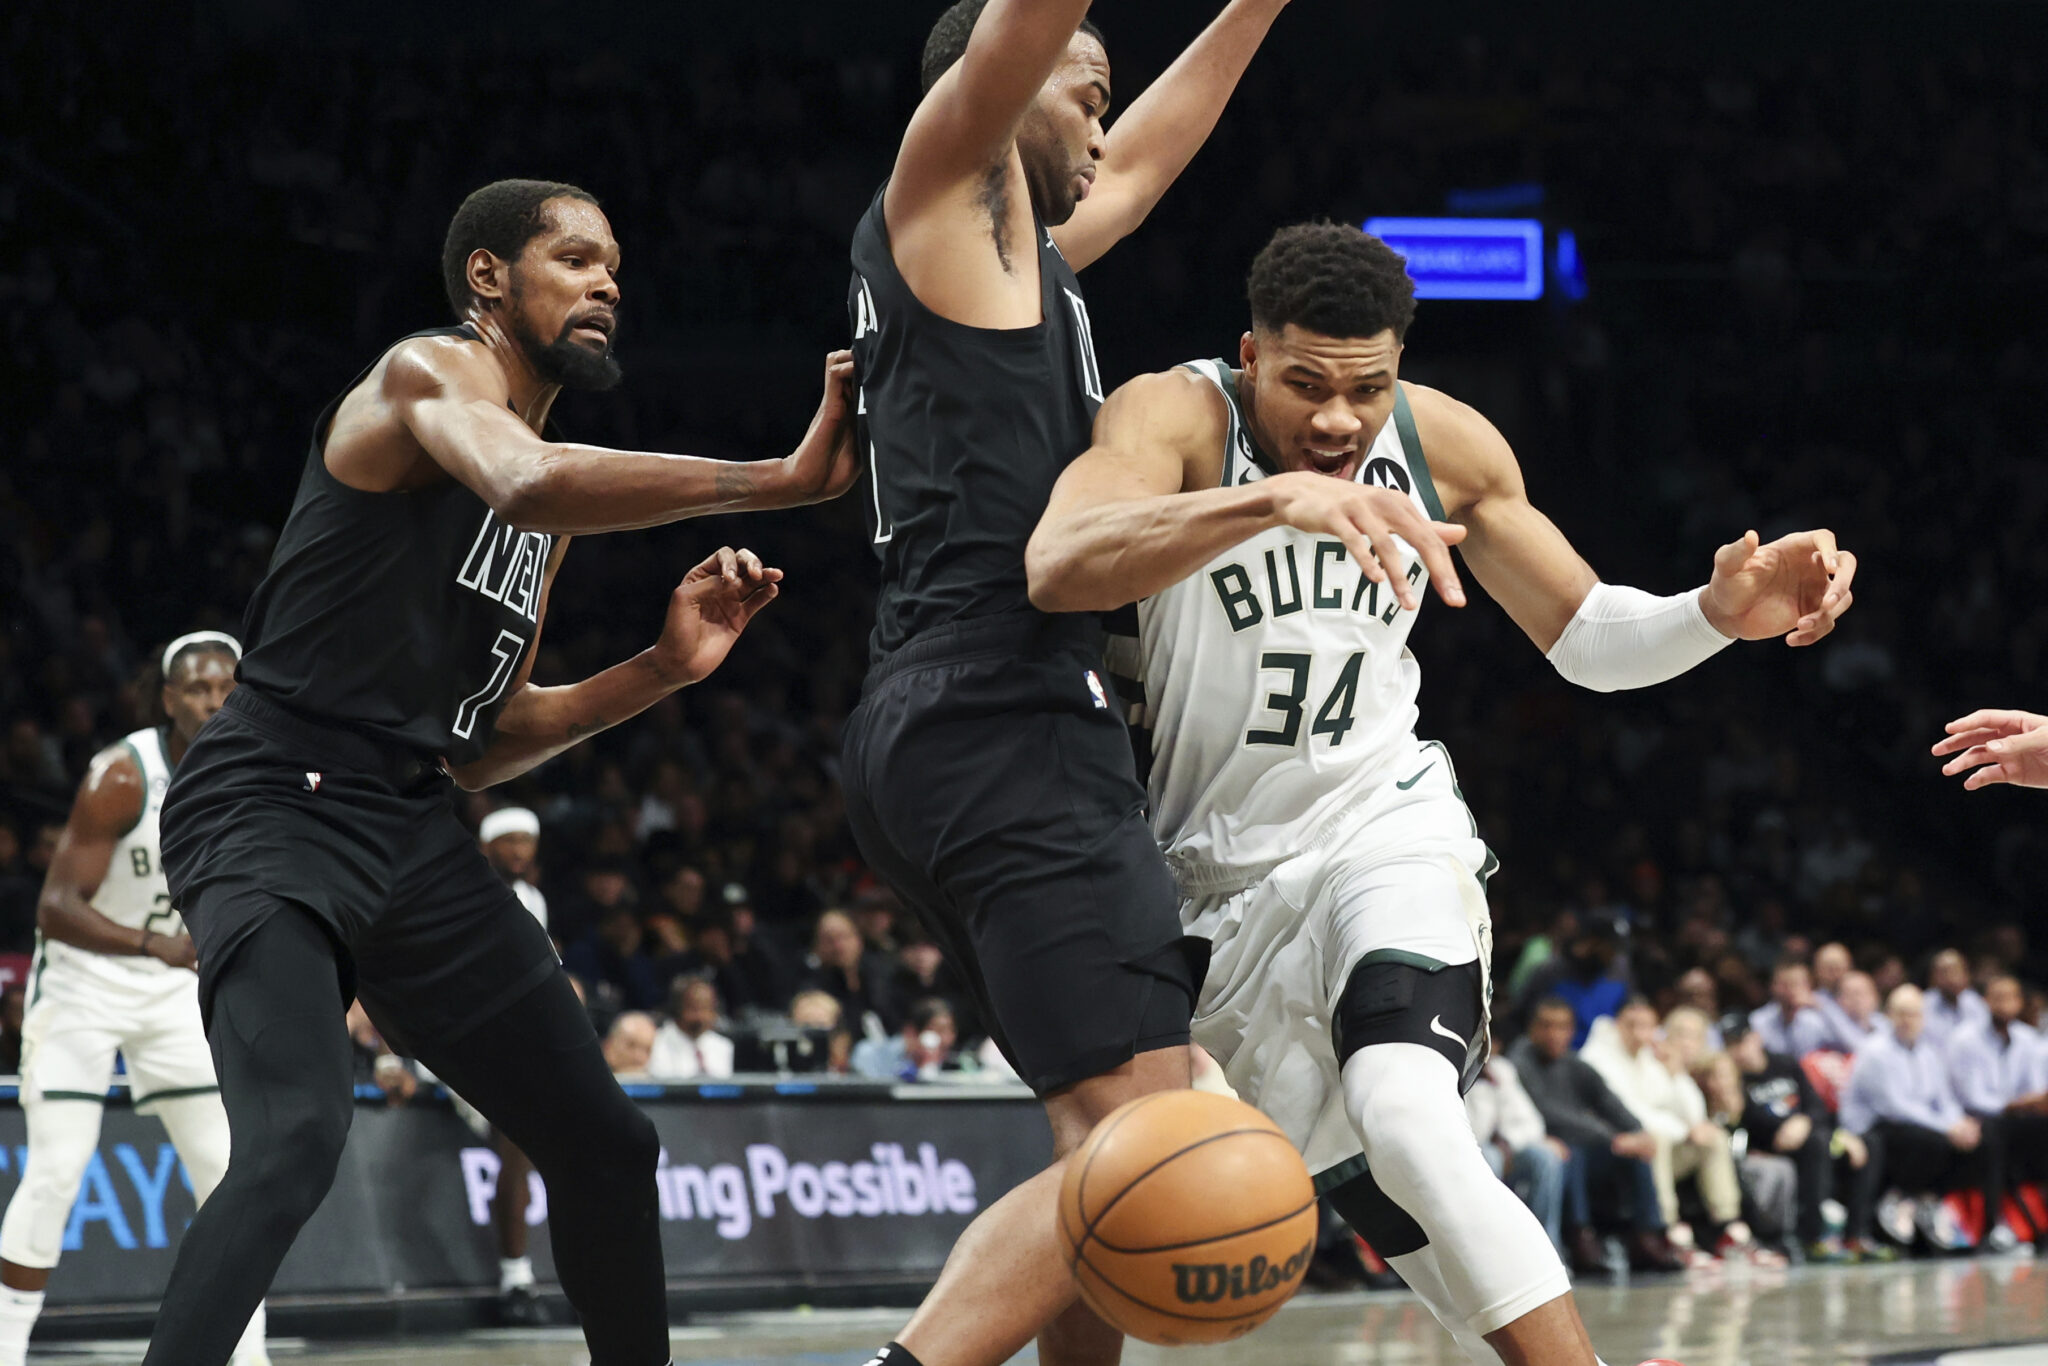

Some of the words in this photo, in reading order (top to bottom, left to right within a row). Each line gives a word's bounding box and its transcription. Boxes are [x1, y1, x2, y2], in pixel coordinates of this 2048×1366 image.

[452, 629, 525, 740] 7
[1243, 649, 1368, 753] 34
[745, 1142, 978, 1219] Possible
